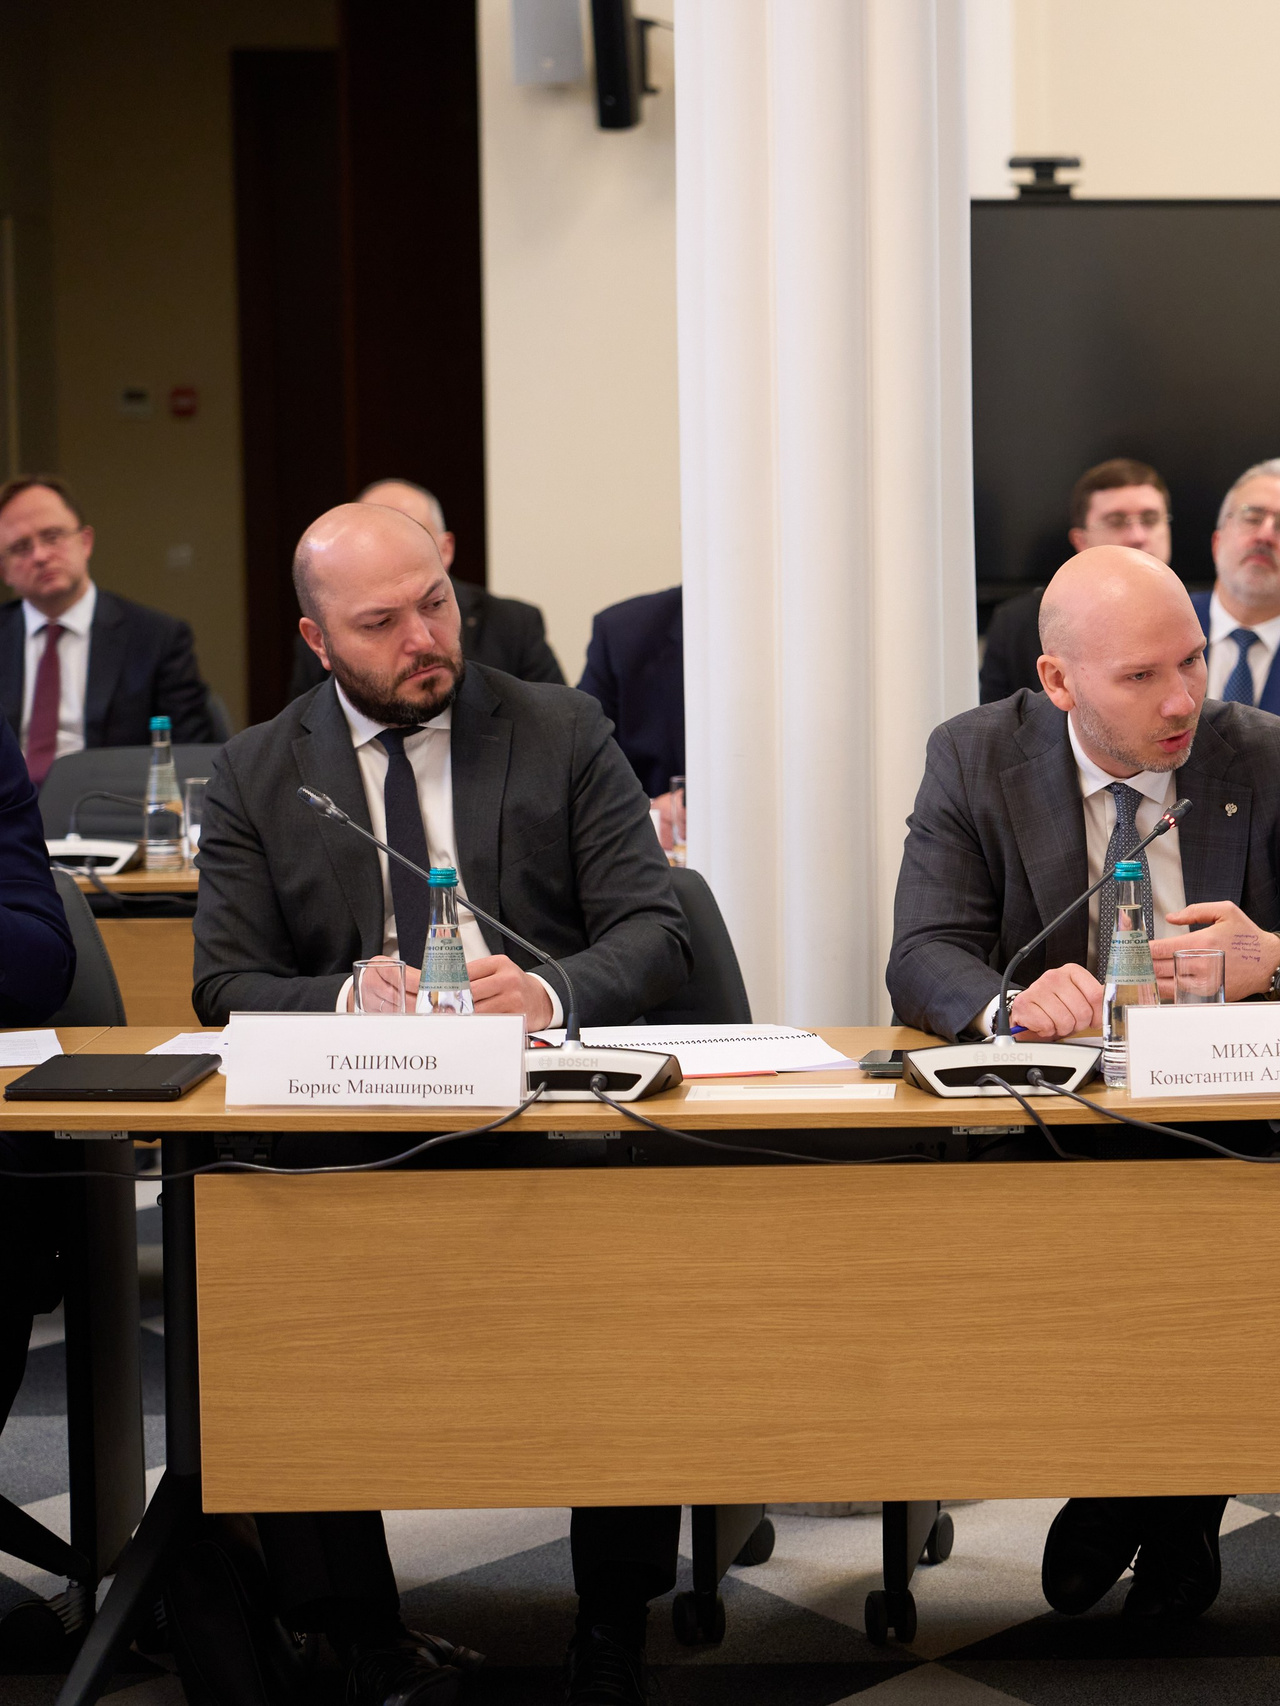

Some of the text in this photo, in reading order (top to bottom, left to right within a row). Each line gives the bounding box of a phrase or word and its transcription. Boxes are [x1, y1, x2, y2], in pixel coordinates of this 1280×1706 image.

[326, 1054, 438, 1070] ТАШИМОВ
[558, 1057, 598, 1067] BOSCH
[993, 1053, 1033, 1062] BOSCH
[1150, 1069, 1254, 1086] Константин
[288, 1079, 475, 1098] Борис Манаширович
